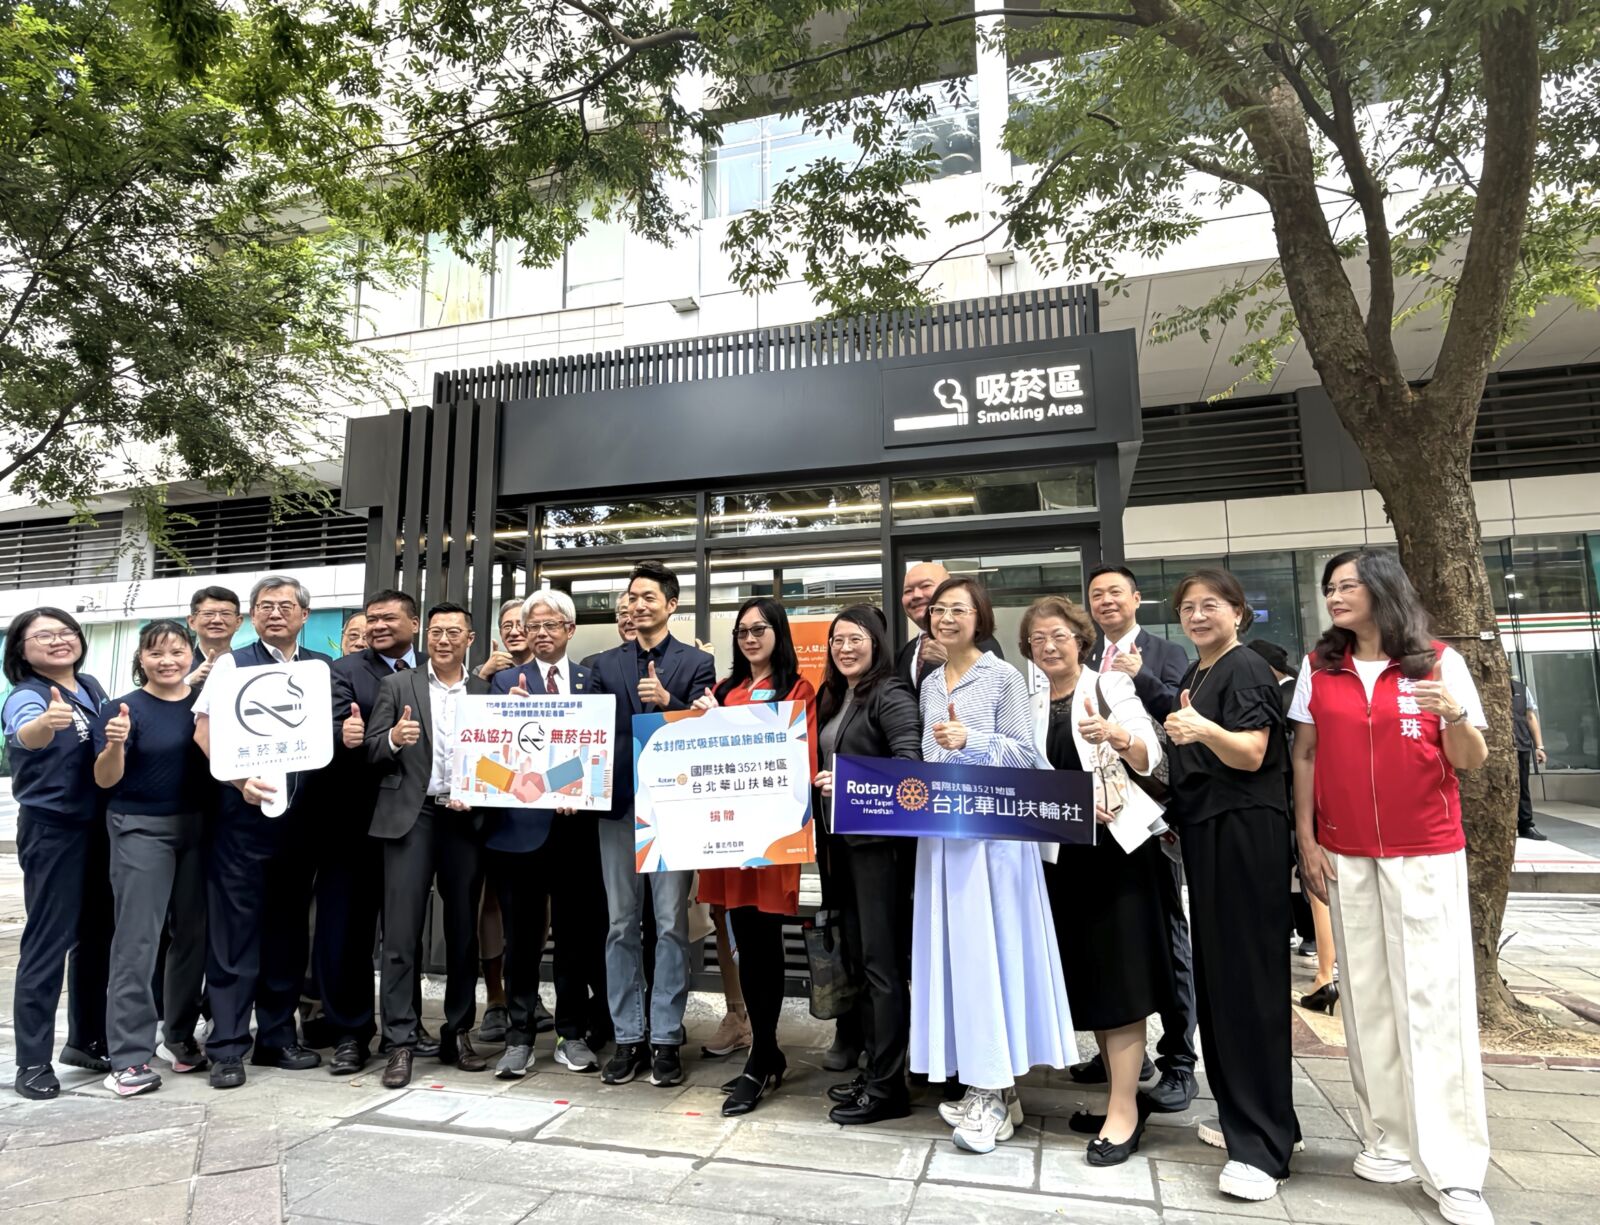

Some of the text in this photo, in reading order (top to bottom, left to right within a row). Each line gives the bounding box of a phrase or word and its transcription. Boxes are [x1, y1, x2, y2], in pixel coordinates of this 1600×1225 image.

[976, 364, 1084, 406] 吸菸區
[977, 402, 1084, 424] Smoking Area
[460, 729, 607, 744] 公私協力 無菸台北
[692, 775, 789, 793] 台北華山扶輪社
[846, 780, 894, 797] Rotary
[931, 794, 1084, 822] 台北華山扶輪社
